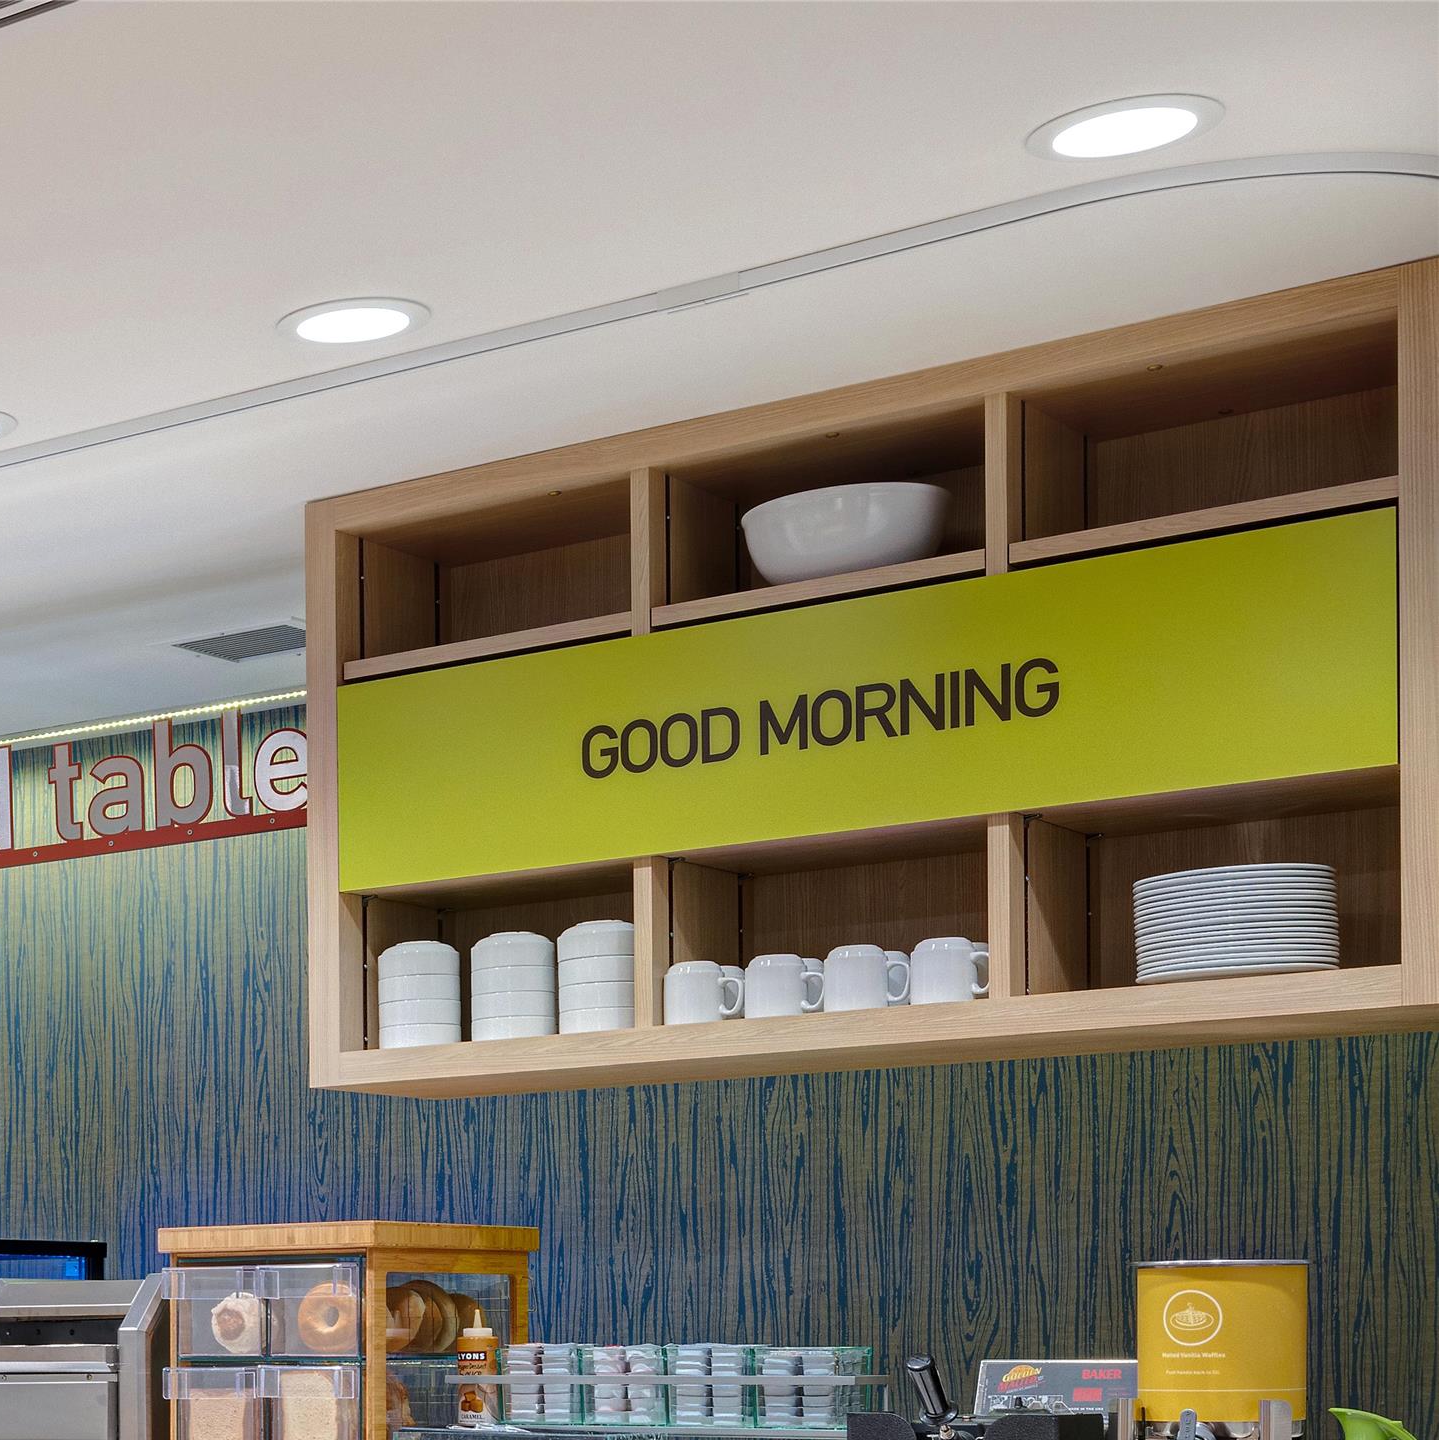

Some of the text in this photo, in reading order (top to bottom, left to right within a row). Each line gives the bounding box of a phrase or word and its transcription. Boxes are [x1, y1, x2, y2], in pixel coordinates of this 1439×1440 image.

[49, 707, 307, 843] table
[581, 657, 1060, 779] GOOD MORNING
[1081, 1368, 1122, 1380] BAKER
